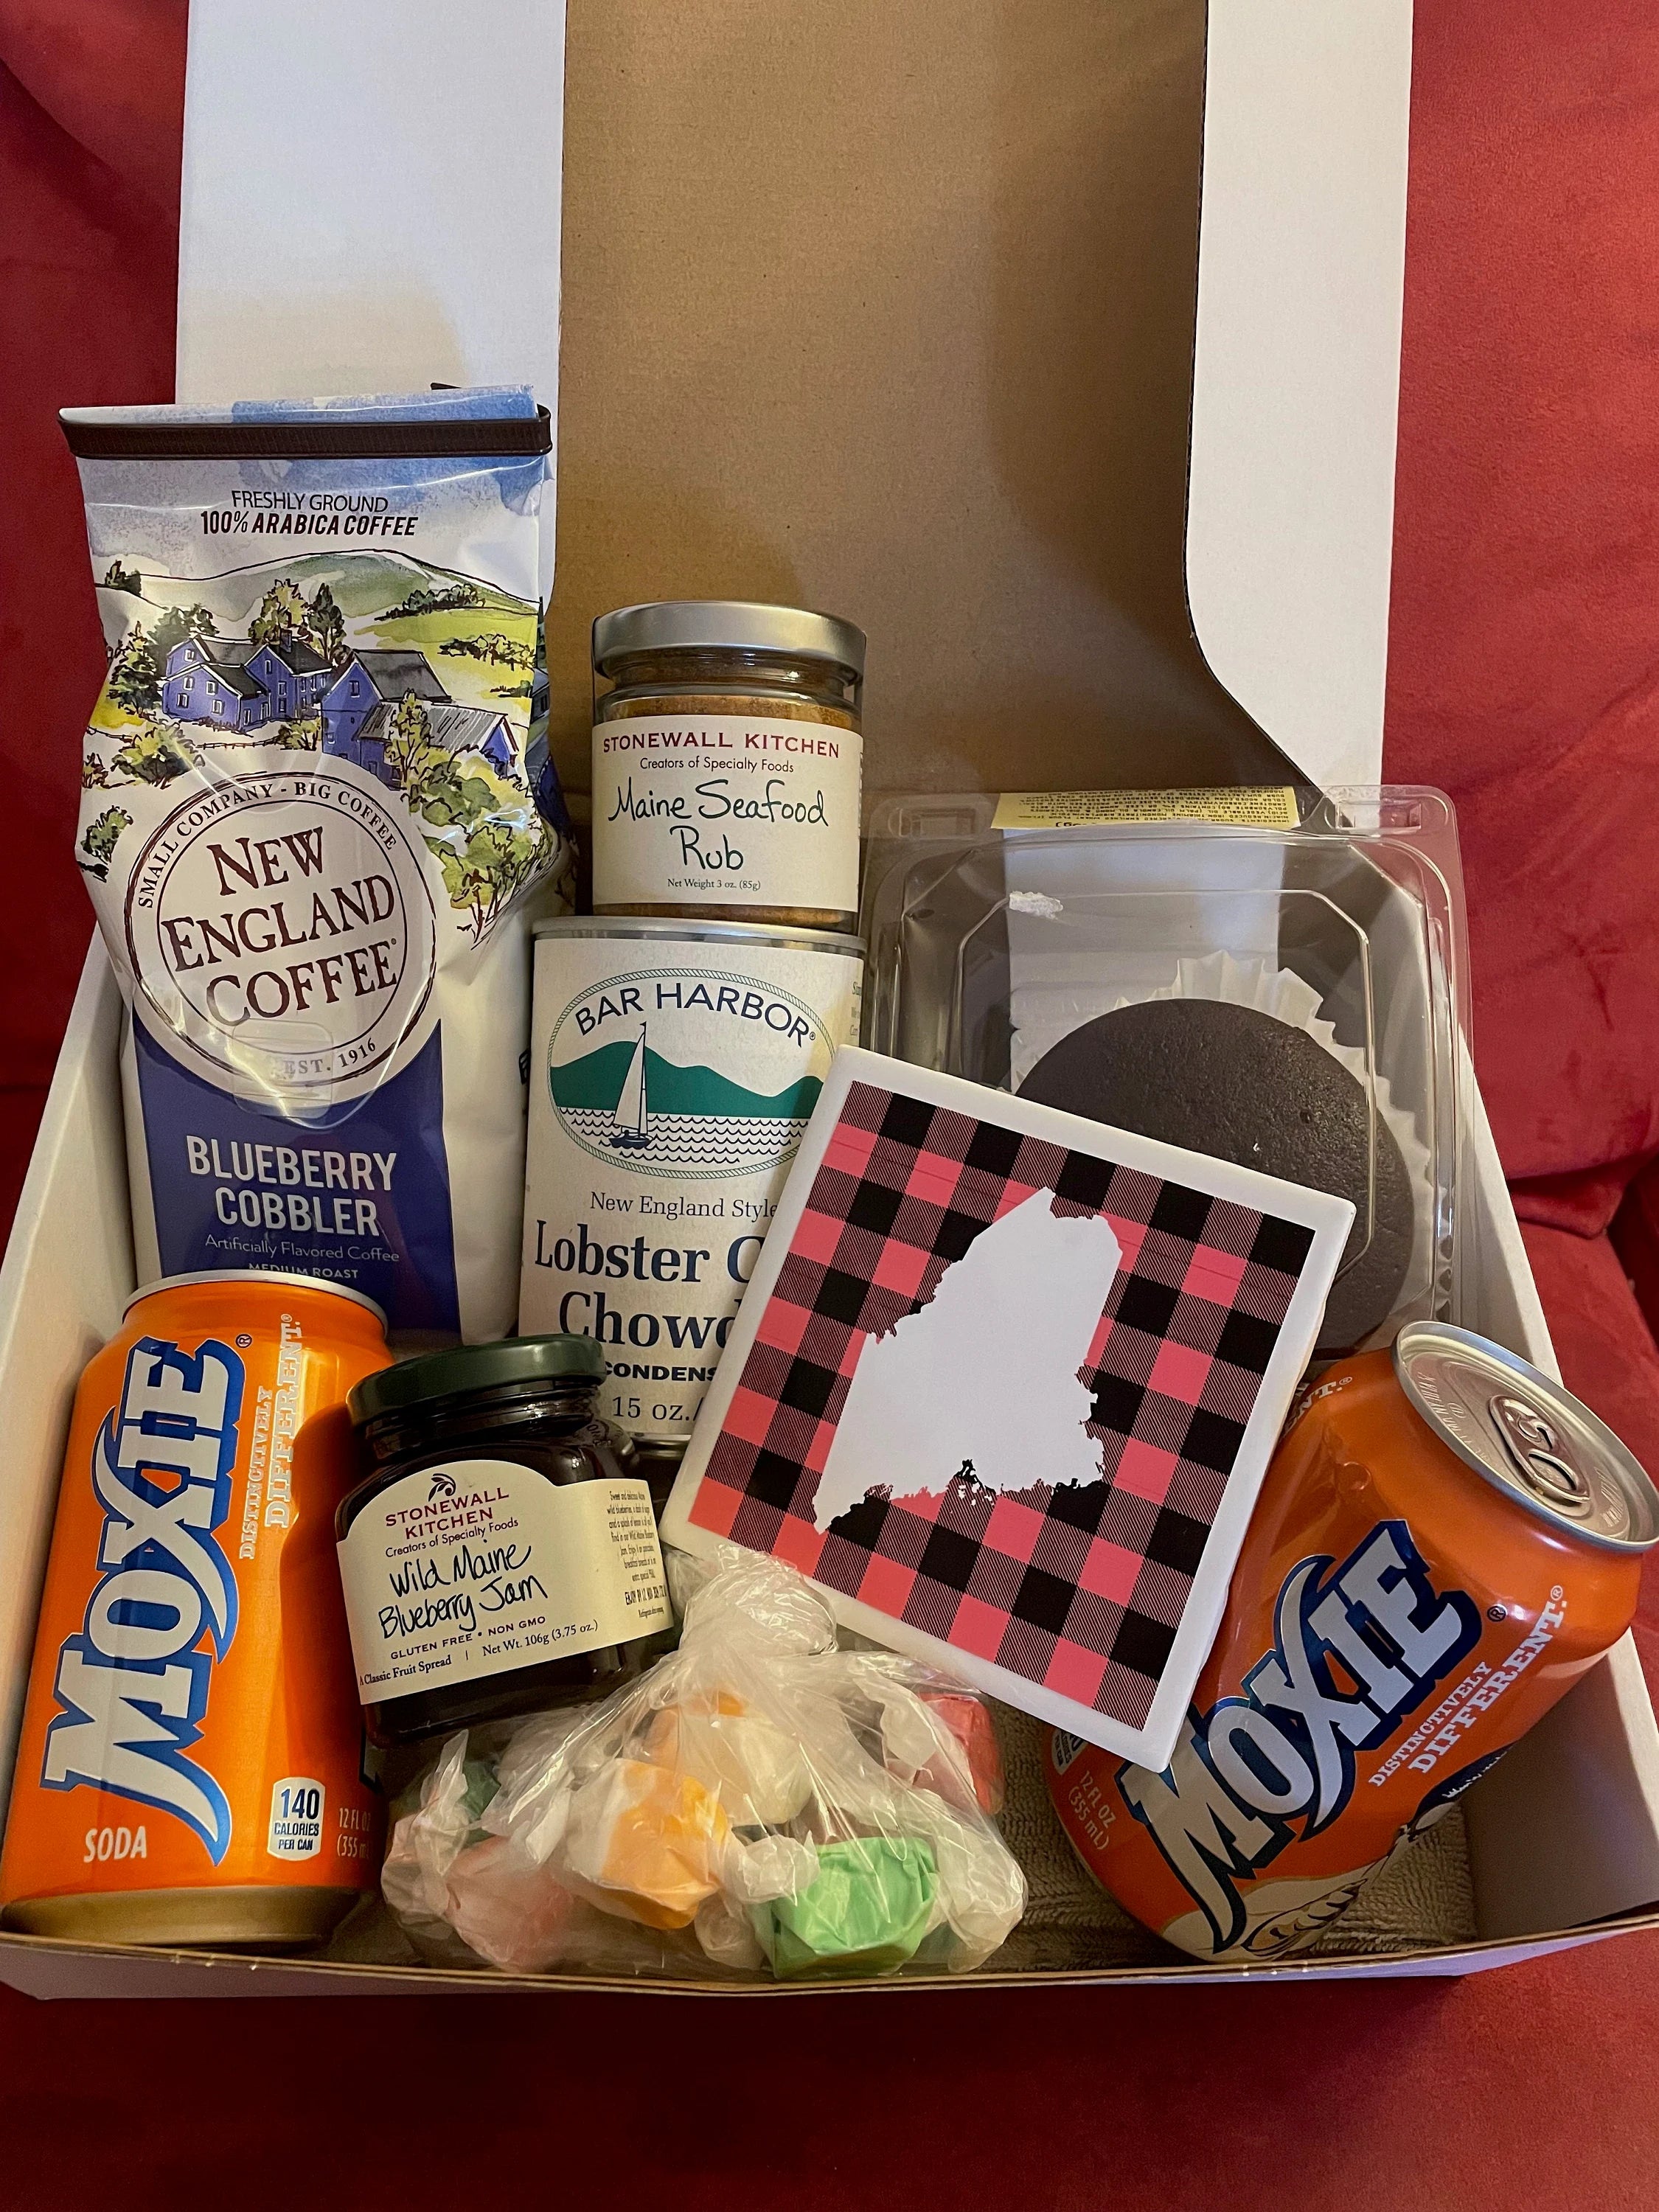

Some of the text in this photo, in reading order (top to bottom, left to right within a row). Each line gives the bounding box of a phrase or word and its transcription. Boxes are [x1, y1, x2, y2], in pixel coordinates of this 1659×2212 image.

[232, 490, 389, 514] FRESHLY GROUND
[201, 509, 419, 538] 100% ARABICA COFFEE
[603, 731, 839, 759] STONEWALL KITCHEN
[640, 756, 794, 773] Creators of Specialty Foods
[608, 776, 692, 822] Maine
[695, 779, 829, 827] Seafood
[139, 782, 397, 908] SMALL COMPANY BIG COFFEE
[206, 827, 323, 896] NEW
[670, 825, 743, 870] Rub
[667, 878, 681, 888] Net
[684, 878, 714, 890] Weight
[717, 879, 722, 888] 3
[739, 880, 761, 891] (85g)
[161, 874, 395, 972] ENGLAND
[206, 940, 397, 1026] COFFEE
[576, 983, 810, 1047] BAR HARBOR
[338, 1037, 376, 1068] 1916
[186, 1135, 397, 1191] BLUEBERRY
[215, 1187, 380, 1237] COBBLER
[590, 1192, 778, 1222] New England Style
[205, 1234, 400, 1262] Artificially Flavored Coffee
[535, 1220, 710, 1284] Lobster
[313, 1267, 358, 1279] ROAST
[613, 1397, 641, 1418] 15
[240, 1386, 273, 1559] DISTINCTIVELY
[386, 1486, 509, 1528] STONEWALL
[405, 1506, 493, 1540] KITCHEN
[386, 1517, 519, 1558] Creators of Specialty Foods
[389, 1540, 532, 1598] Wild Maine
[40, 1336, 246, 1866] MOXIE
[378, 1575, 548, 1639] Blueberry Jam
[391, 1615, 546, 1660] GLUTEN FREE NON GMO
[482, 1618, 599, 1657] Net Wt. 106g (3.75 oz.)
[364, 1671, 392, 1686] Classic
[393, 1663, 417, 1680] Fruit
[418, 1655, 452, 1673] Spread
[1114, 1520, 1482, 1954] MOXIE
[1368, 1661, 1492, 1787] DISTINCTIVELY
[281, 1787, 320, 1820] 140
[339, 1807, 349, 1829] 12
[350, 1809, 359, 1830] FL
[1069, 1785, 1110, 1851] (355 mL)
[1080, 1770, 1117, 1829] 12 FL OZ
[83, 1826, 147, 1863] SODA
[274, 1822, 319, 1837] CALORIES
[279, 1839, 313, 1851] PER CAN
[337, 1833, 358, 1858] (355
